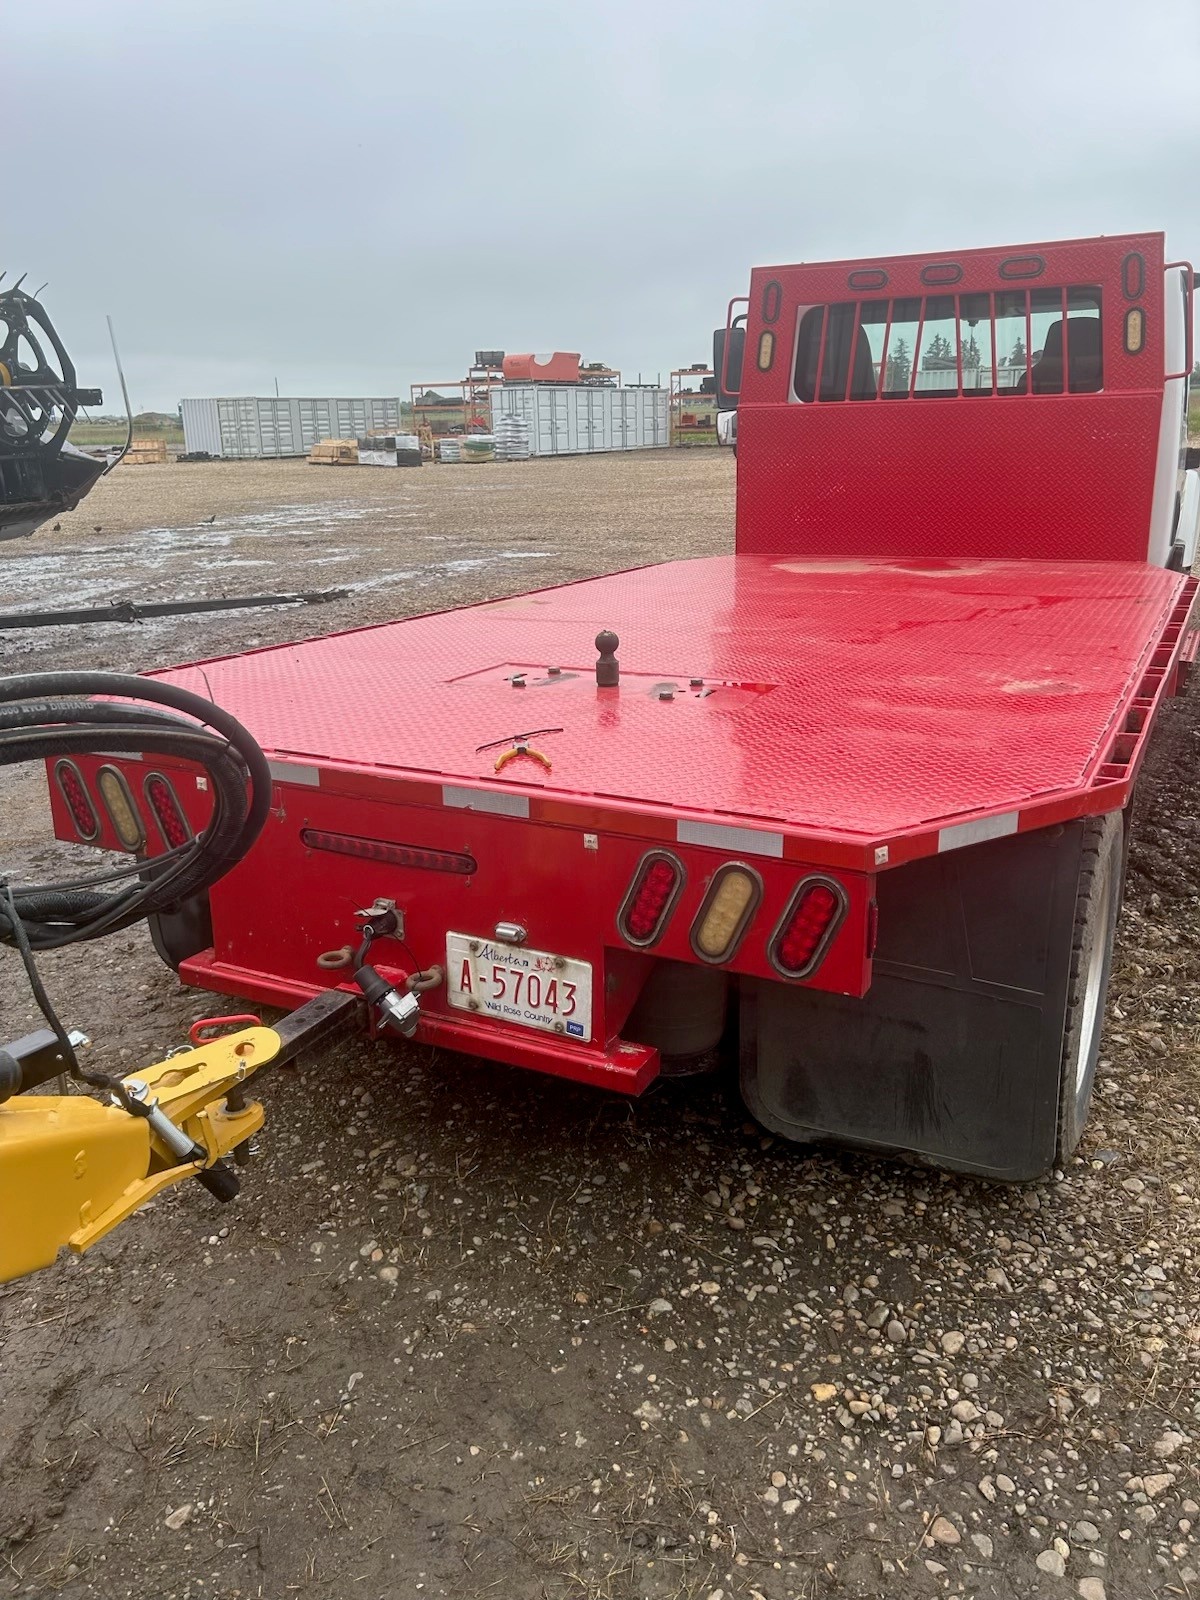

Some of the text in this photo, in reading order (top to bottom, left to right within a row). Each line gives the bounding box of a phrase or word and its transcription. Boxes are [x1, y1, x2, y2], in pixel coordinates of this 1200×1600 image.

[0, 706, 19, 716] 000
[49, 702, 94, 711] DIEHARD
[460, 958, 577, 1016] A-57043
[484, 1000, 553, 1024] Wild Rose Country
